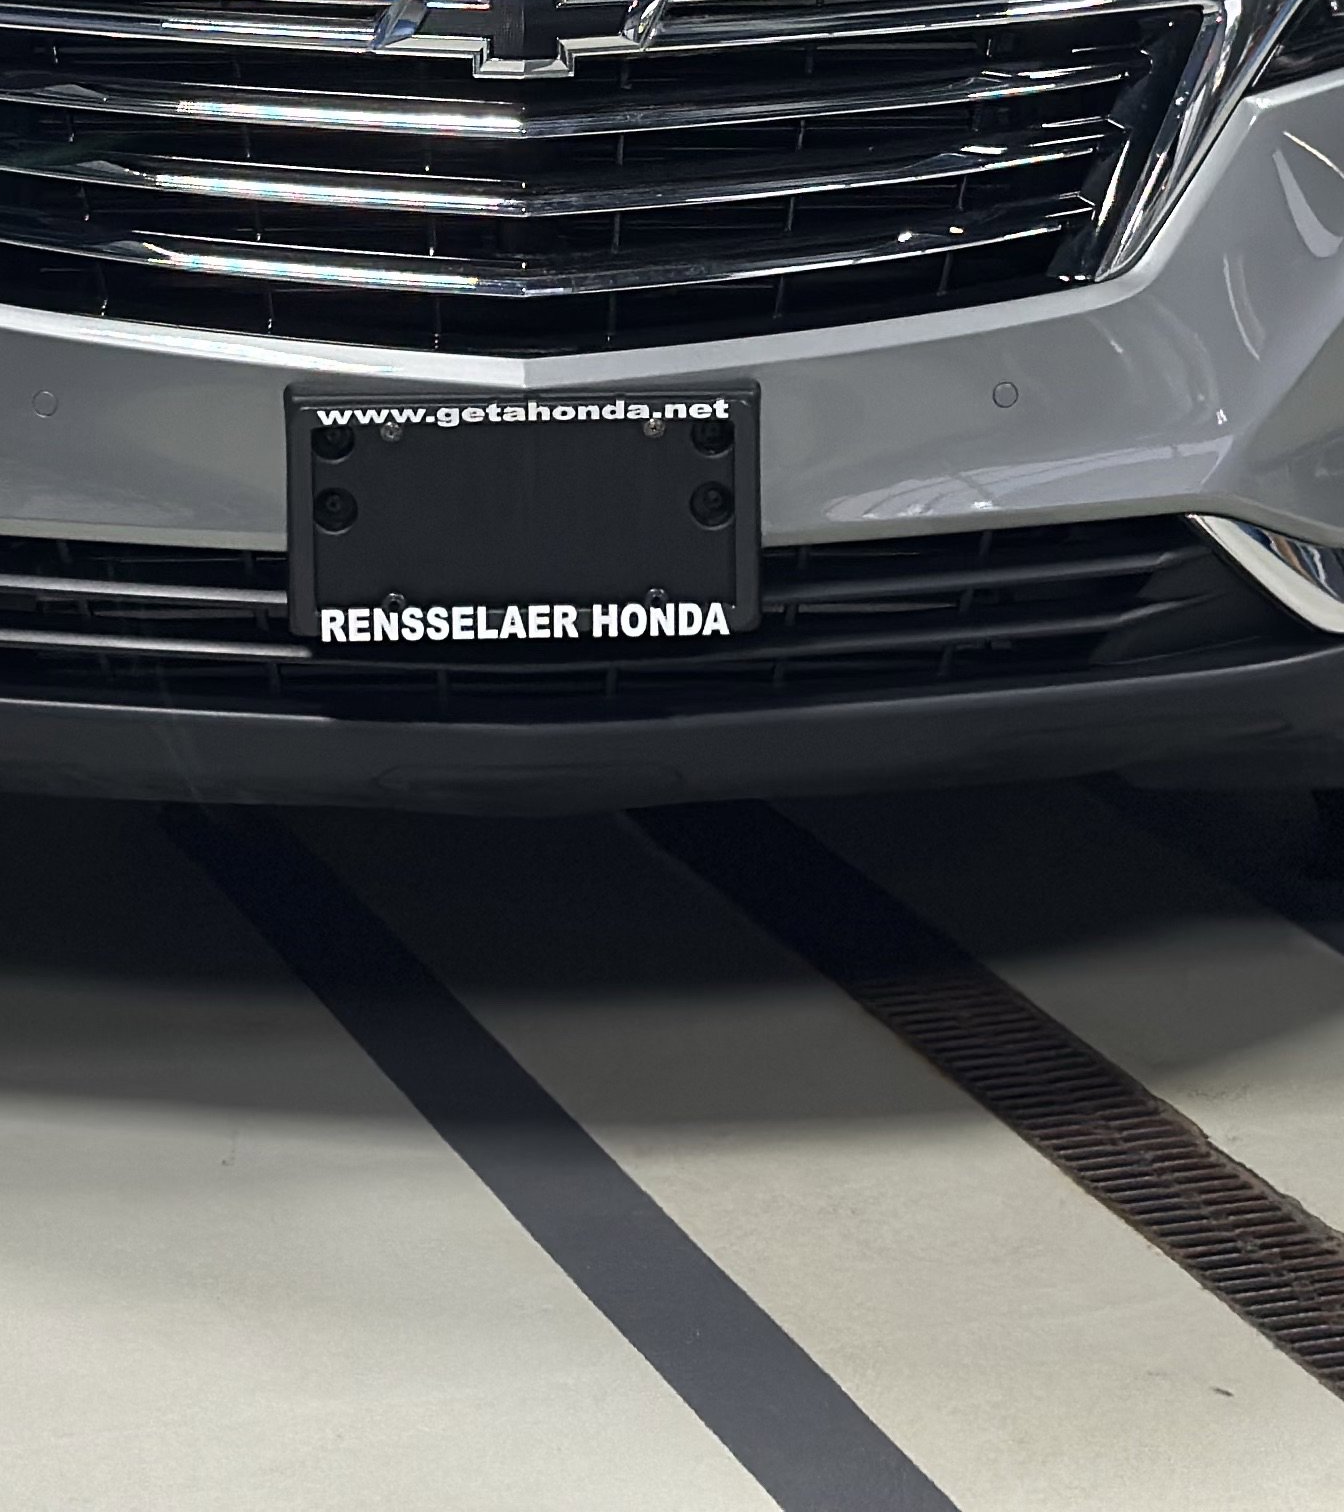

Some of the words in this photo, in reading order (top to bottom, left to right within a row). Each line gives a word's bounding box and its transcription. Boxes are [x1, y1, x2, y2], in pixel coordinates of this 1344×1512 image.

[316, 399, 729, 428] www.getahonda.net
[321, 605, 579, 642] RENSSELAER
[592, 602, 730, 638] HONDA
